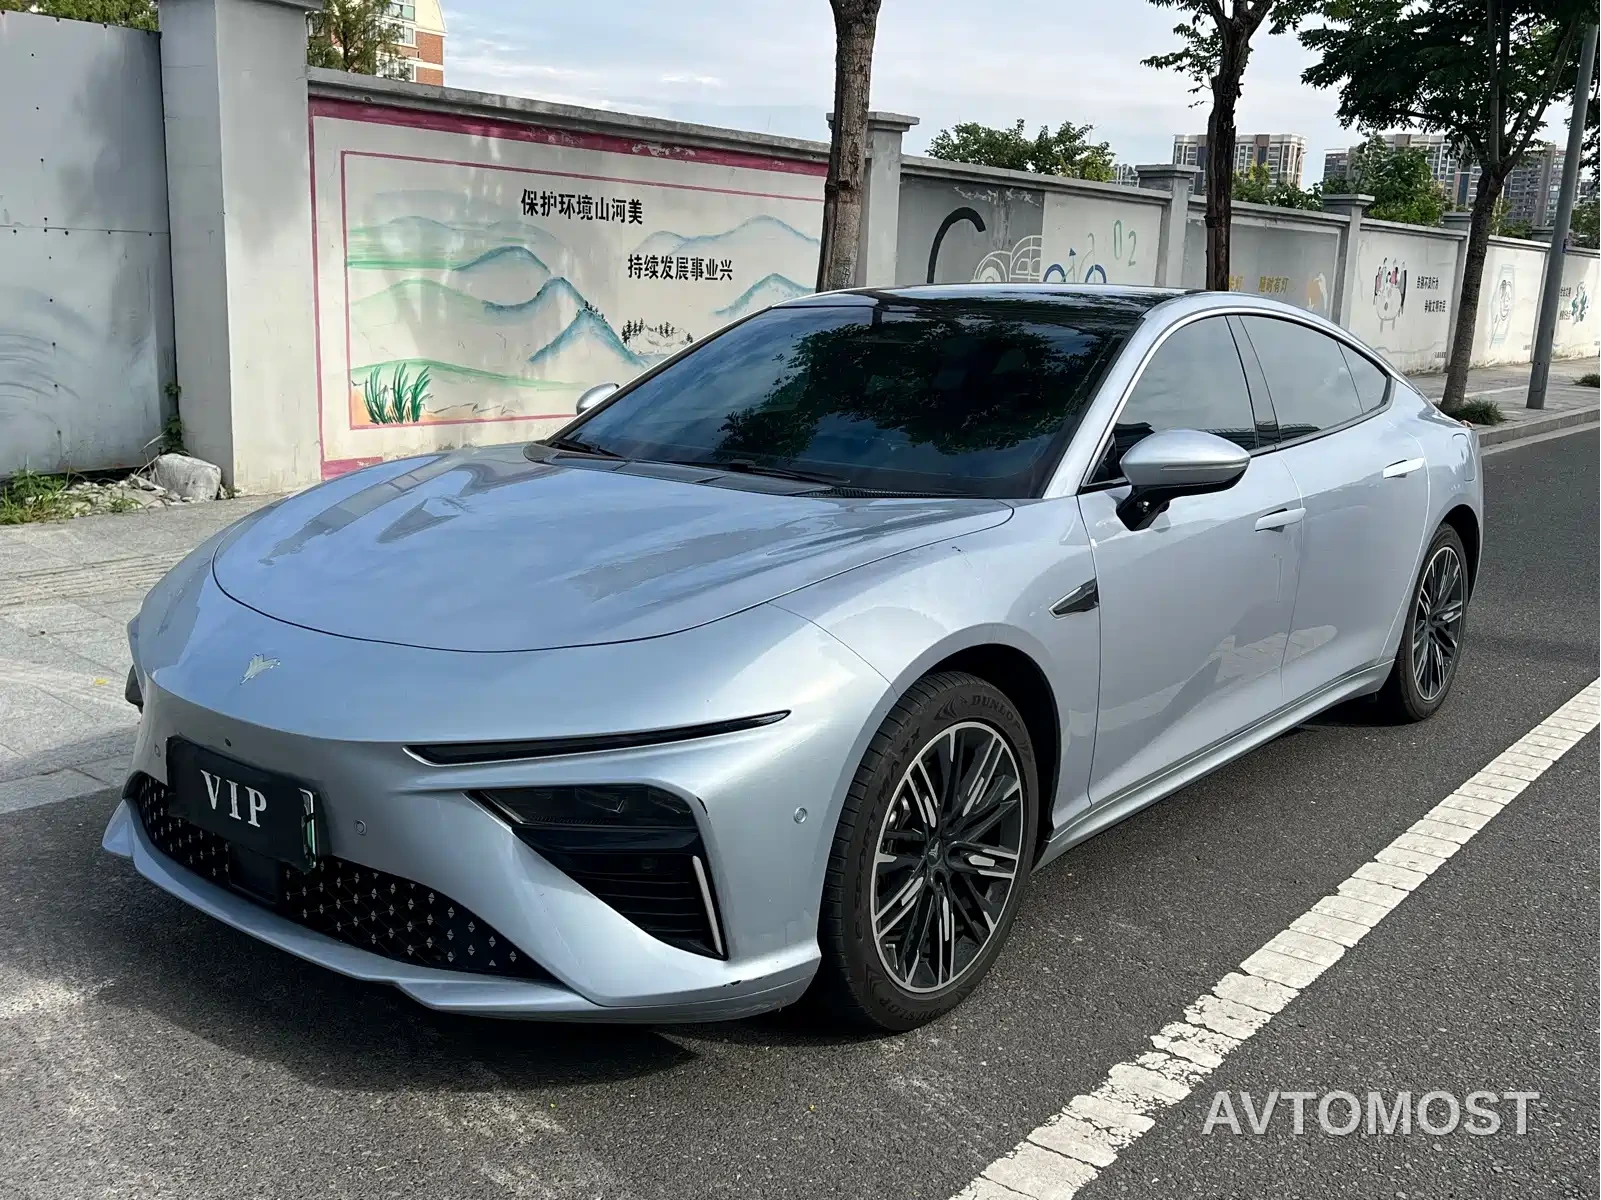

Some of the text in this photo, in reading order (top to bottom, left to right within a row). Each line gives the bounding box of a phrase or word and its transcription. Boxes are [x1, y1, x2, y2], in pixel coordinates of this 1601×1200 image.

[521, 188, 643, 225] 保护环境山河美
[628, 253, 733, 281] 持续发展事业兴
[970, 694, 1021, 730] DUNLOP
[200, 769, 267, 828] VIP
